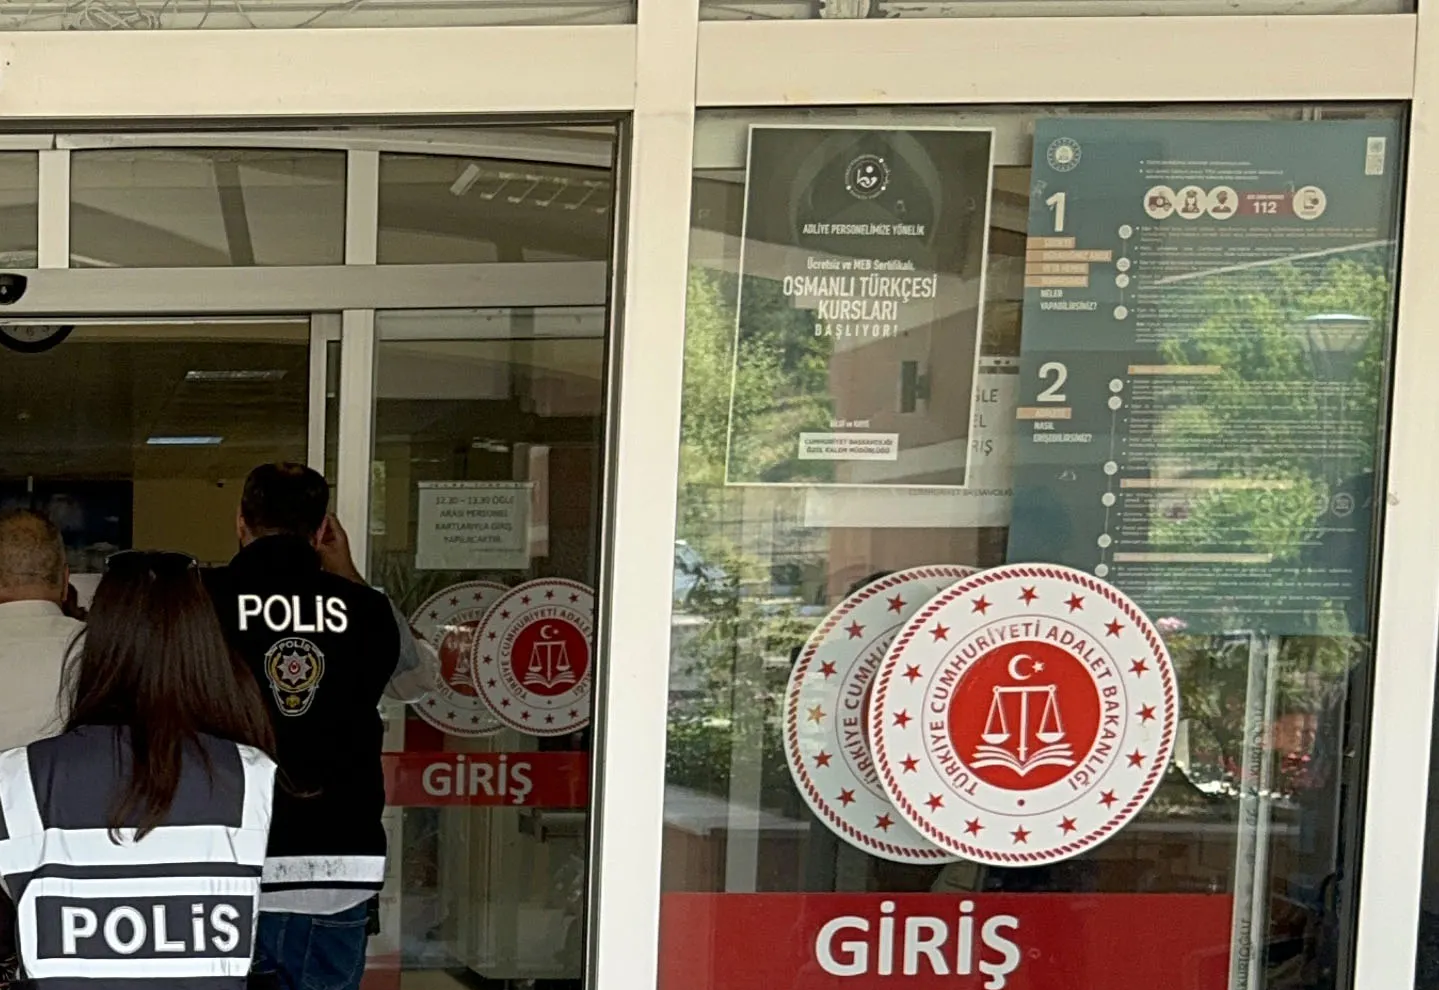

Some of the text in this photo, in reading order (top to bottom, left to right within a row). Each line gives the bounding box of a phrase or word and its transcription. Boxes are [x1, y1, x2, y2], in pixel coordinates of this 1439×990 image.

[1046, 191, 1066, 232] 1
[1252, 201, 1277, 214] 112
[783, 272, 938, 304] OSMANLI TÜRKÇESİ
[817, 299, 898, 321] KURSLARI
[1036, 361, 1068, 402] 2
[929, 619, 1120, 796] TÜRKİYE CUMHURİYETİ ADALET BAKANLIĞI
[422, 753, 534, 805] GİRİŞ
[814, 900, 1022, 990] GİRİŞ
